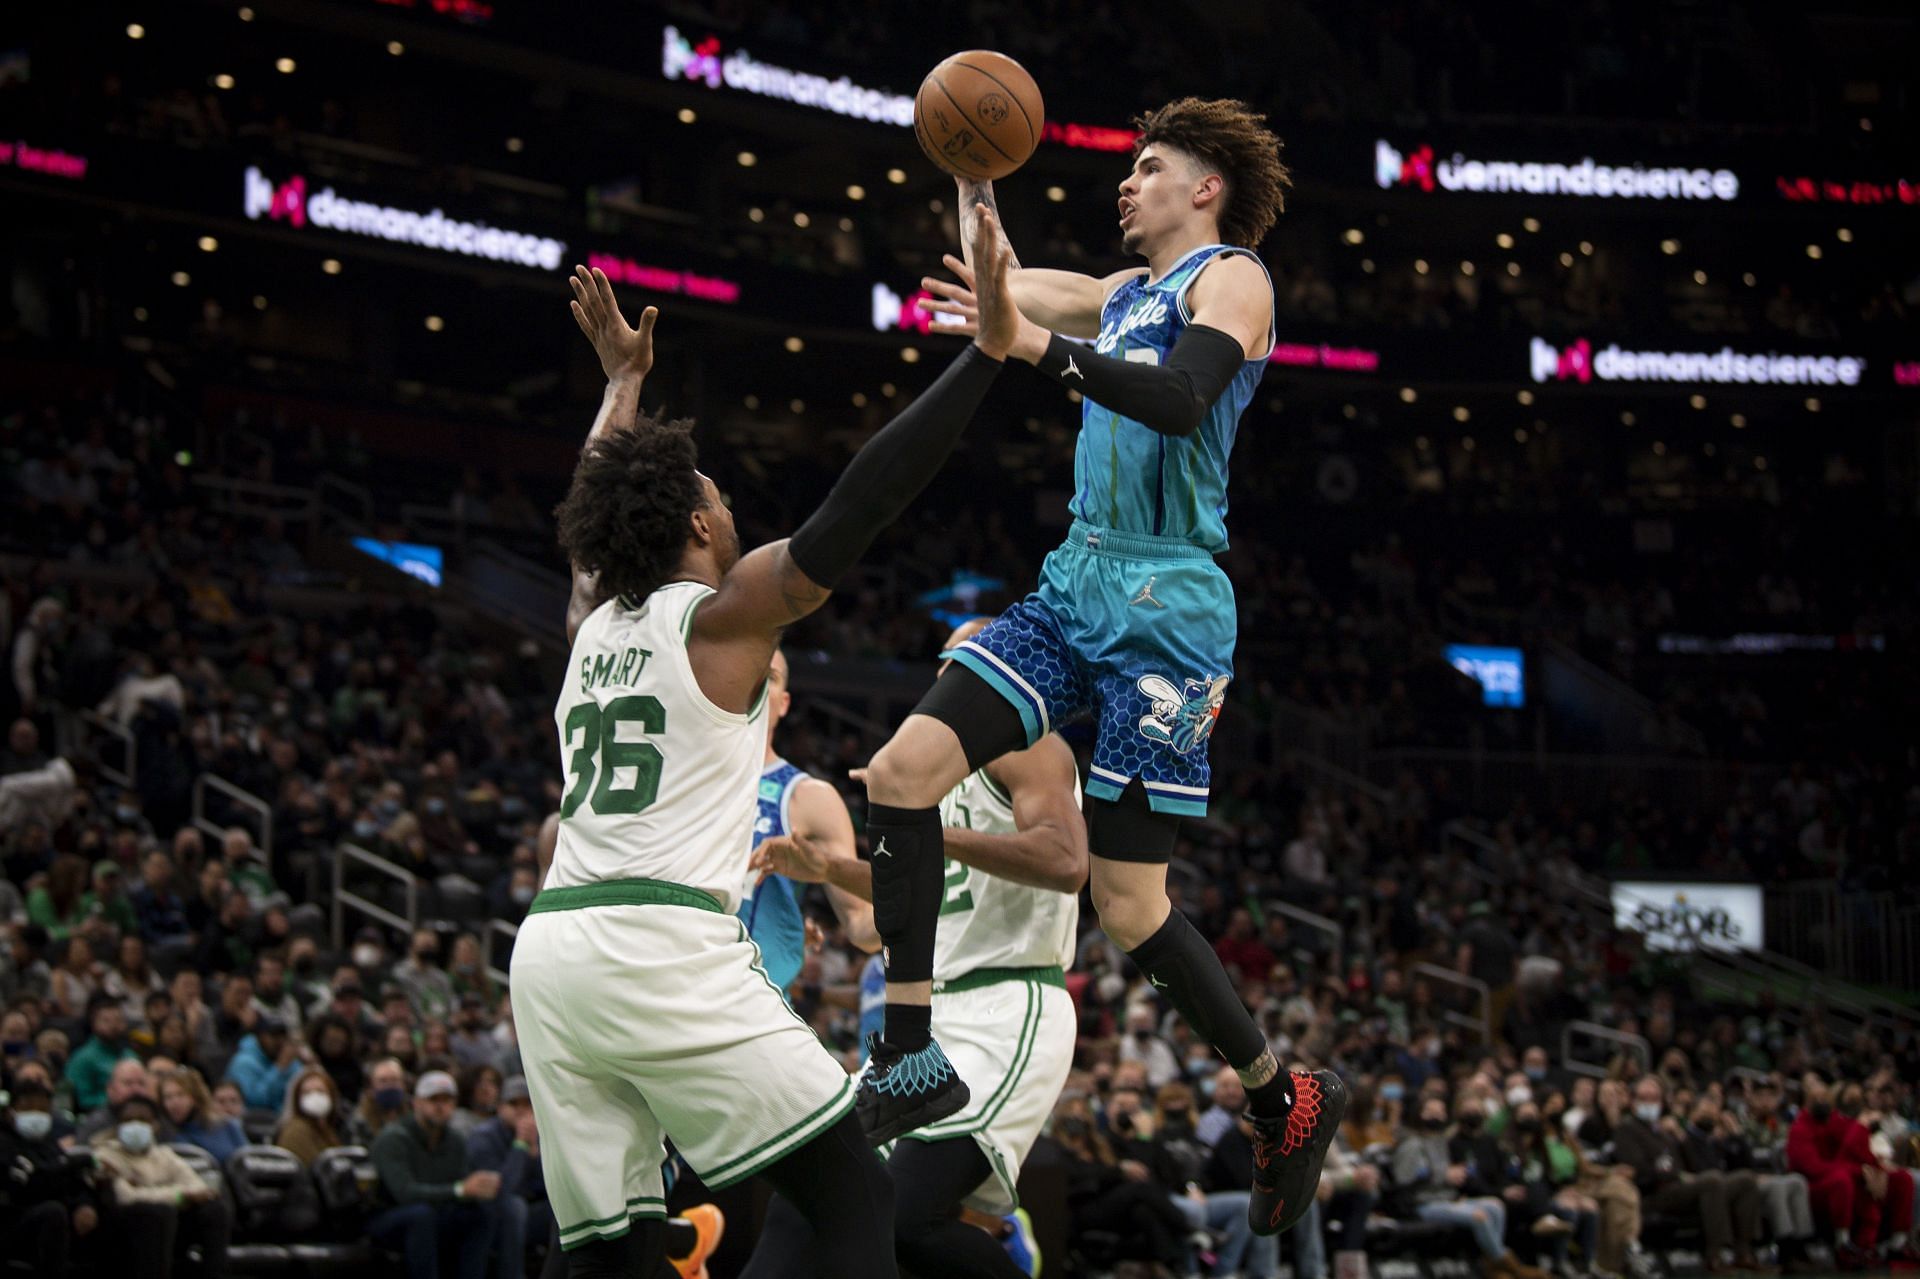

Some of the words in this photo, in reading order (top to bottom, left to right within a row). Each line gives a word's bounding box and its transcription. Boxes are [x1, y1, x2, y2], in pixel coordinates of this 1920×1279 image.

[306, 186, 563, 271] demandscience
[1594, 343, 1861, 385] demandscience
[581, 647, 653, 694] SMART
[560, 695, 667, 822] 36
